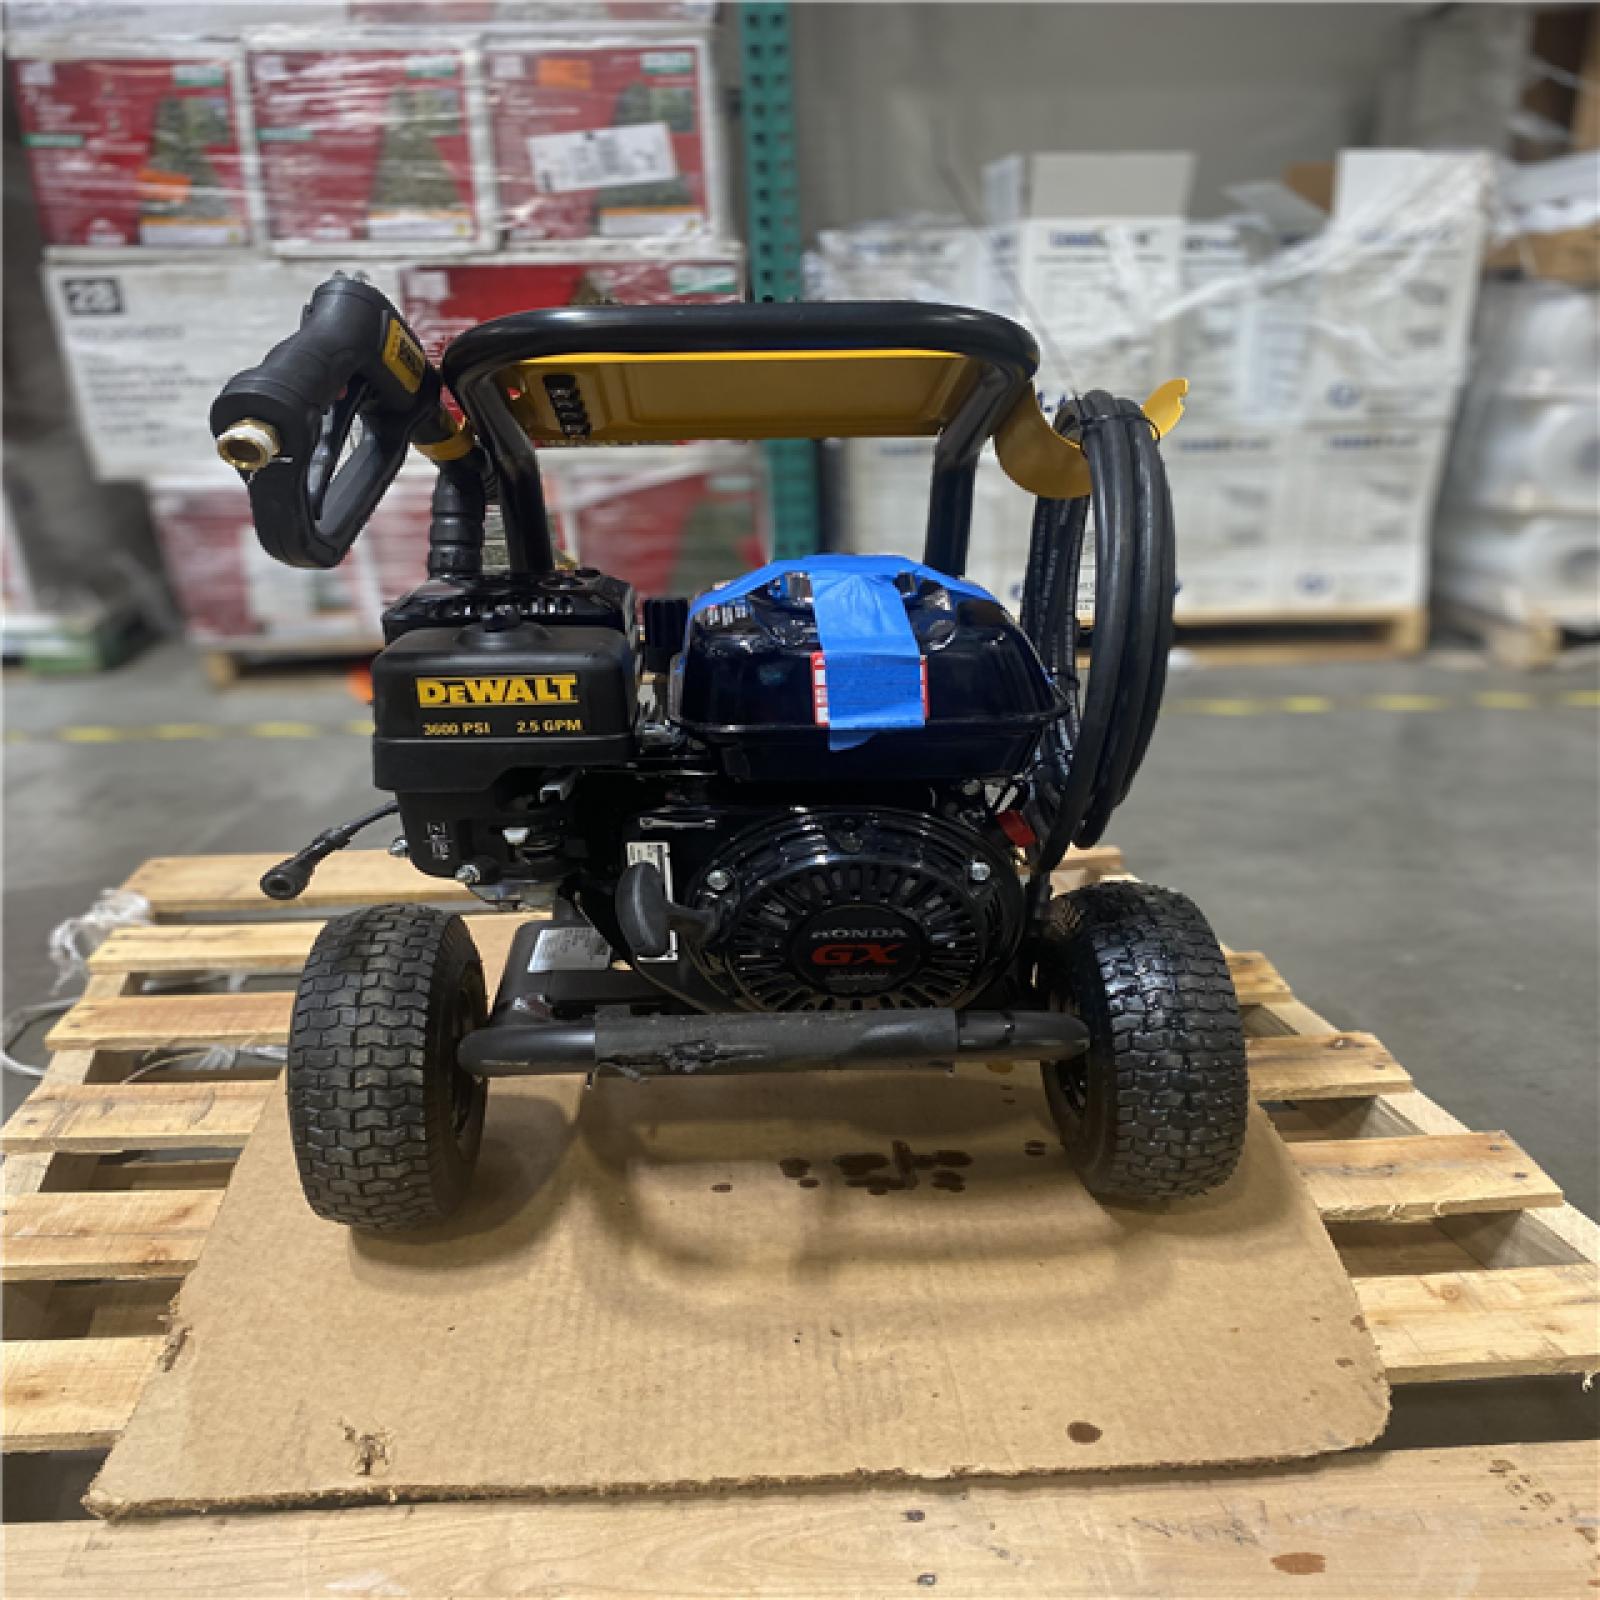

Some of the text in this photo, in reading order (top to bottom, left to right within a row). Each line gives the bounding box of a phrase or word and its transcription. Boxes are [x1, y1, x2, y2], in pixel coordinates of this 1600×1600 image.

[461, 721, 491, 735] PSI
[544, 719, 582, 732] GPM
[811, 928, 906, 938] HONDA
[811, 944, 904, 966] GX
